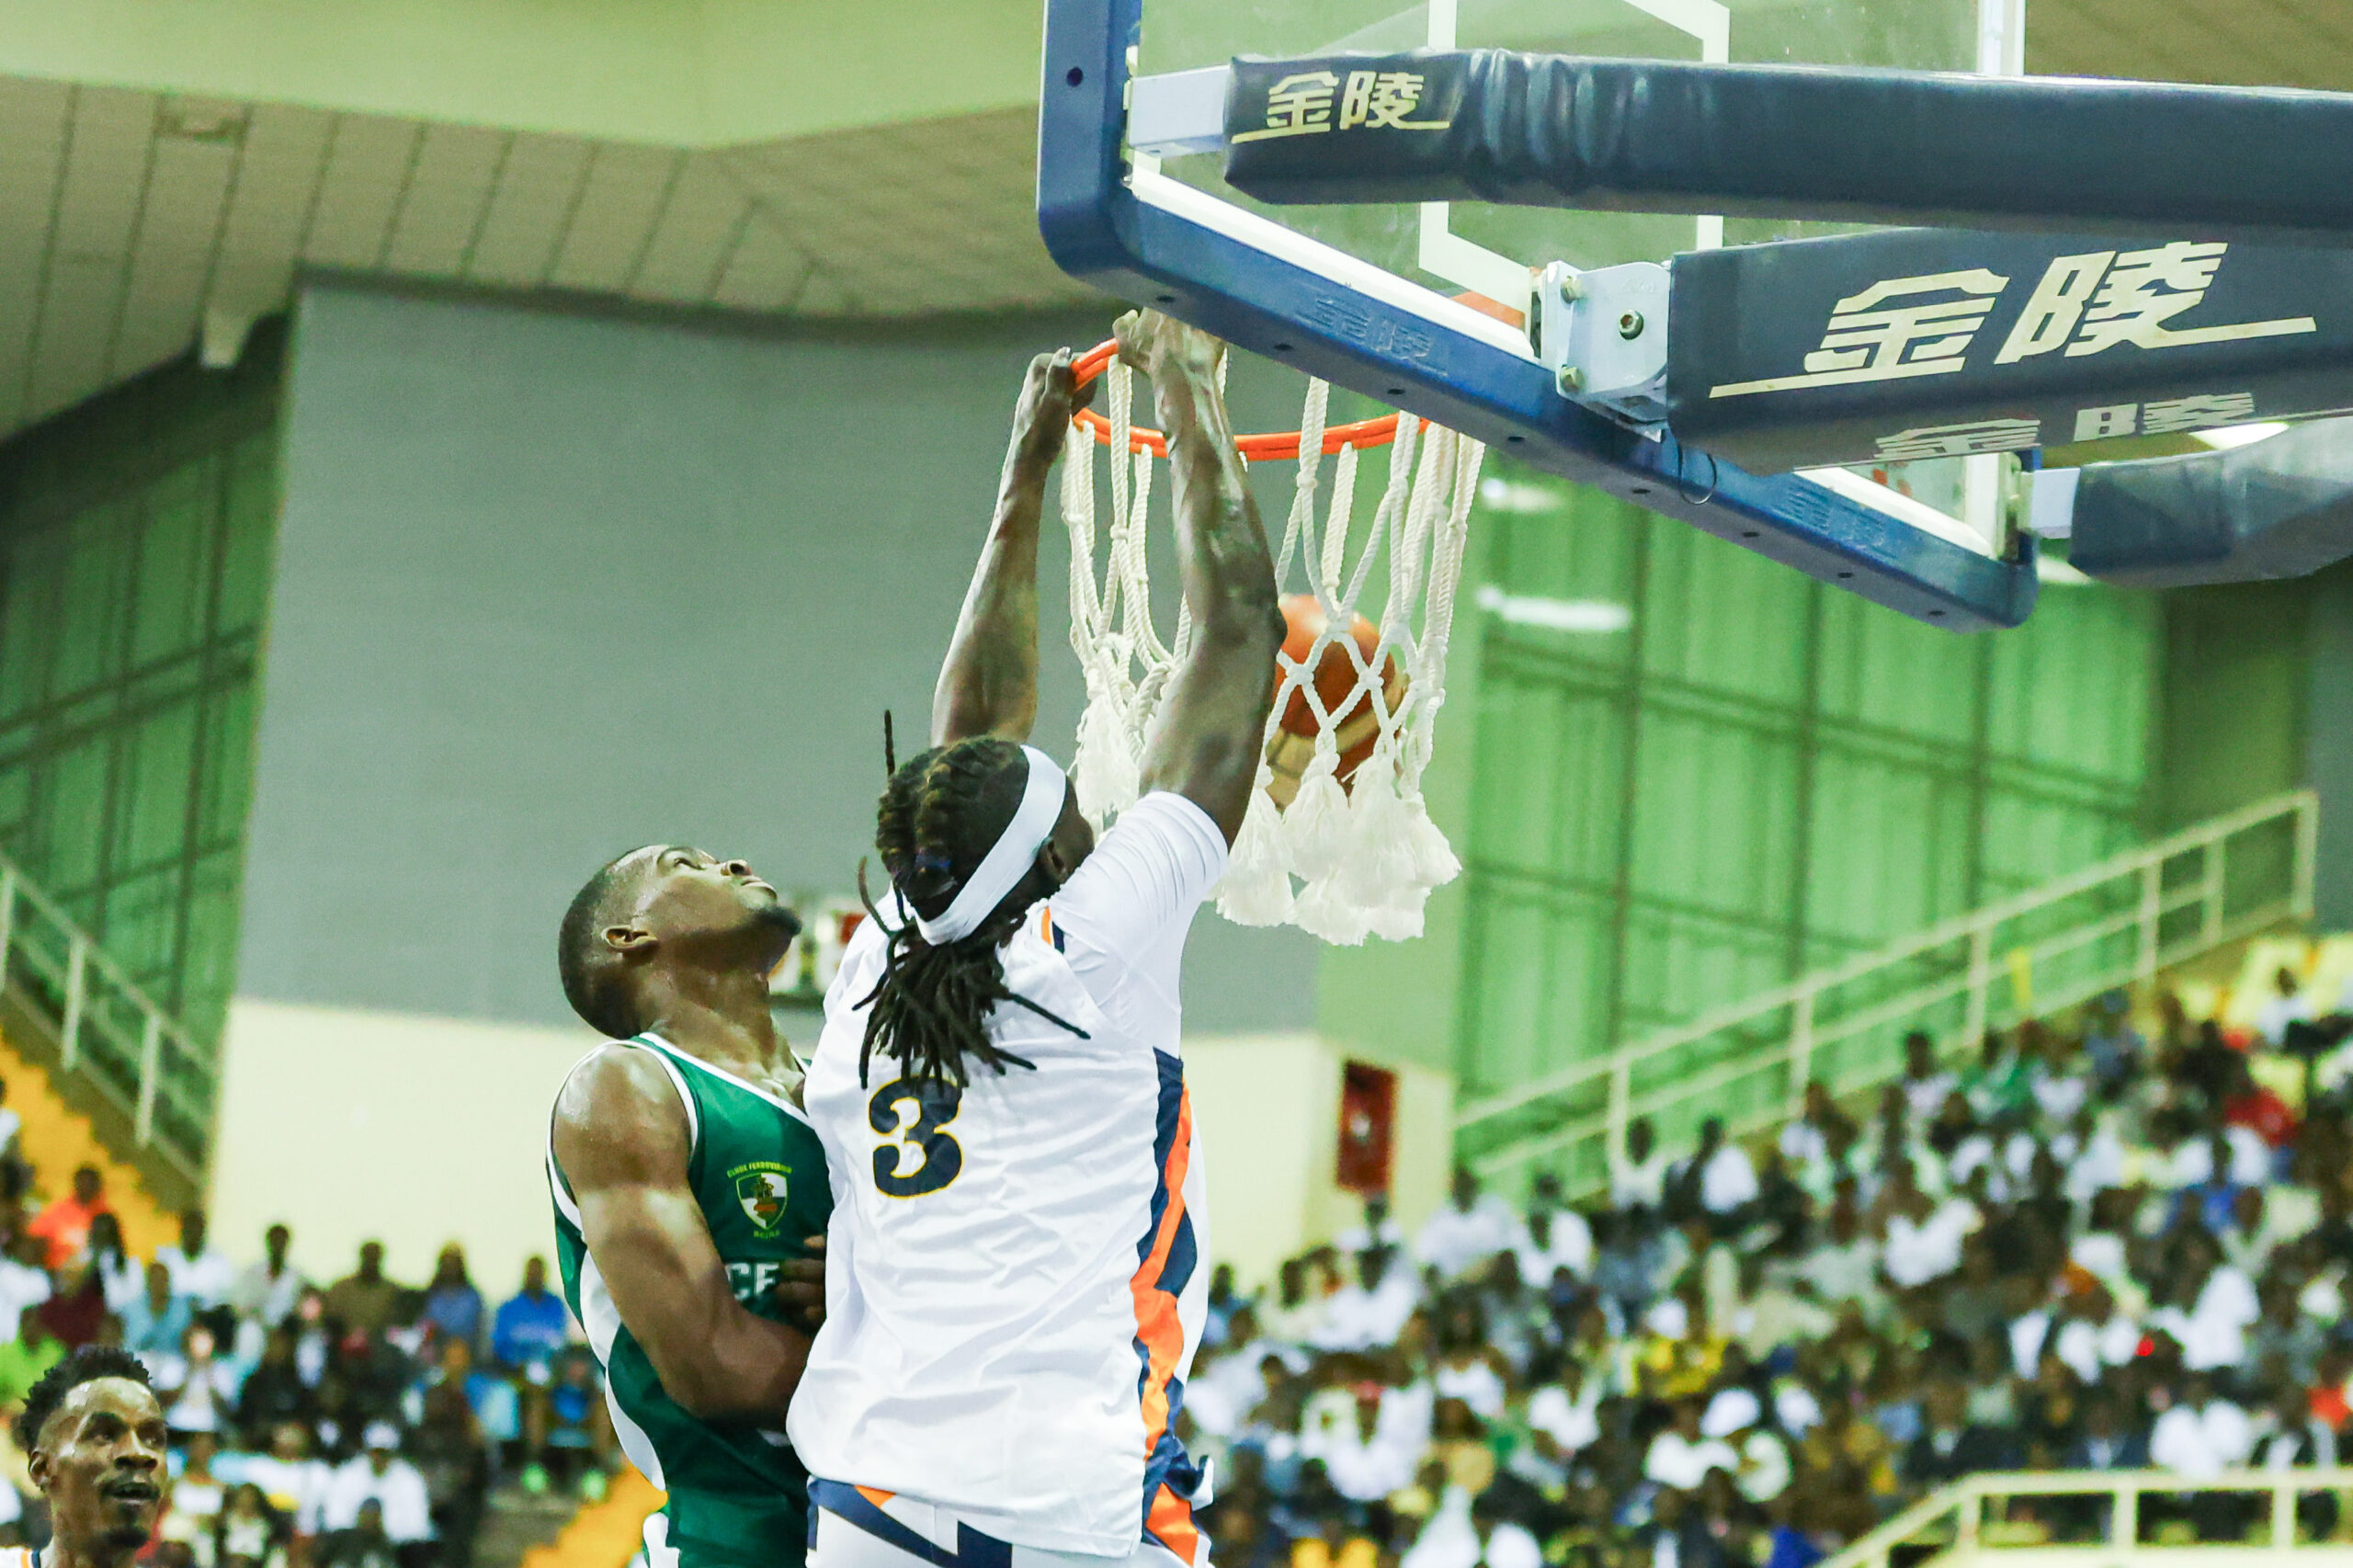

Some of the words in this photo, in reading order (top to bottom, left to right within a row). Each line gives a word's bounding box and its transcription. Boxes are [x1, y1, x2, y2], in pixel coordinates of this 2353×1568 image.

[1231, 70, 1450, 144] 金陵
[1709, 241, 2316, 399] 金陵
[869, 1074, 963, 1199] 3
